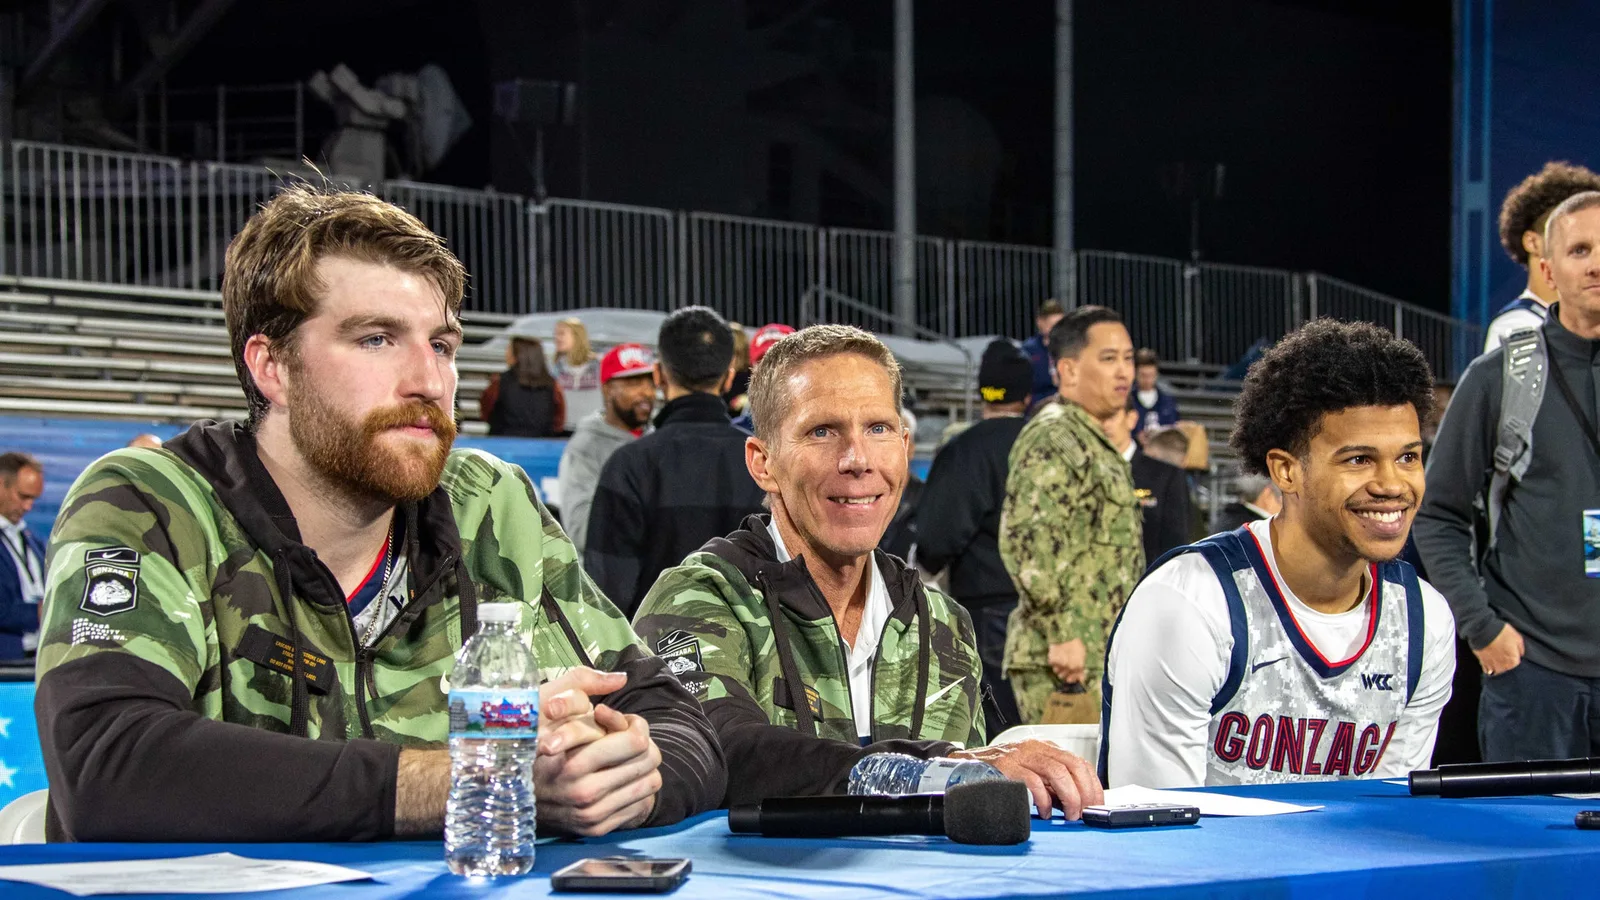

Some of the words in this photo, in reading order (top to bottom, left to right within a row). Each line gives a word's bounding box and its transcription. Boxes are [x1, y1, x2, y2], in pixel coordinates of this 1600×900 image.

[92, 567, 129, 577] GONZAGA
[72, 627, 120, 636] UNIVERSITY
[1361, 673, 1394, 691] WCC
